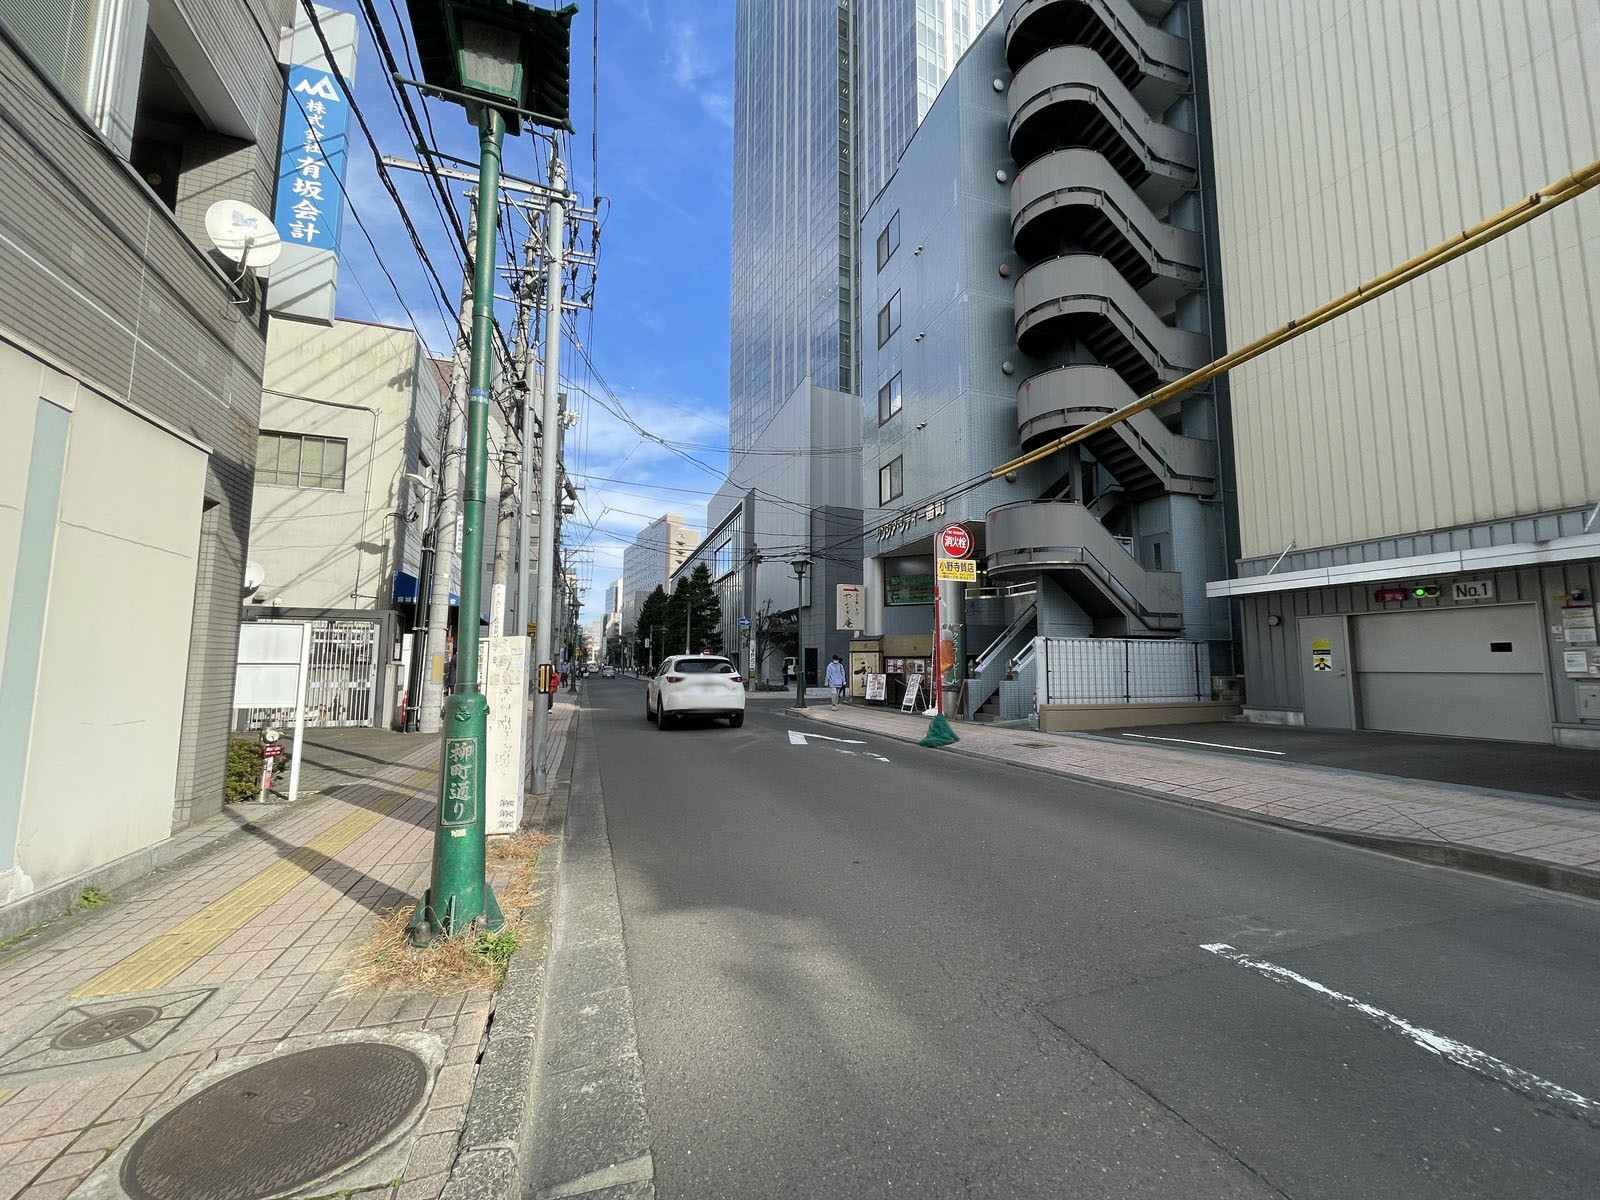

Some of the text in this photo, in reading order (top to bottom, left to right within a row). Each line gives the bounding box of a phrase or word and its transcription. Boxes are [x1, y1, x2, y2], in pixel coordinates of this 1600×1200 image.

[288, 98, 328, 243] 株式会社有坂会計
[945, 535, 967, 549] 消火栓
[939, 561, 975, 573] 小野寺質店
[1456, 583, 1488, 598] No.1
[948, 632, 960, 685] クラフトビール
[448, 742, 474, 820] 柳町通り
